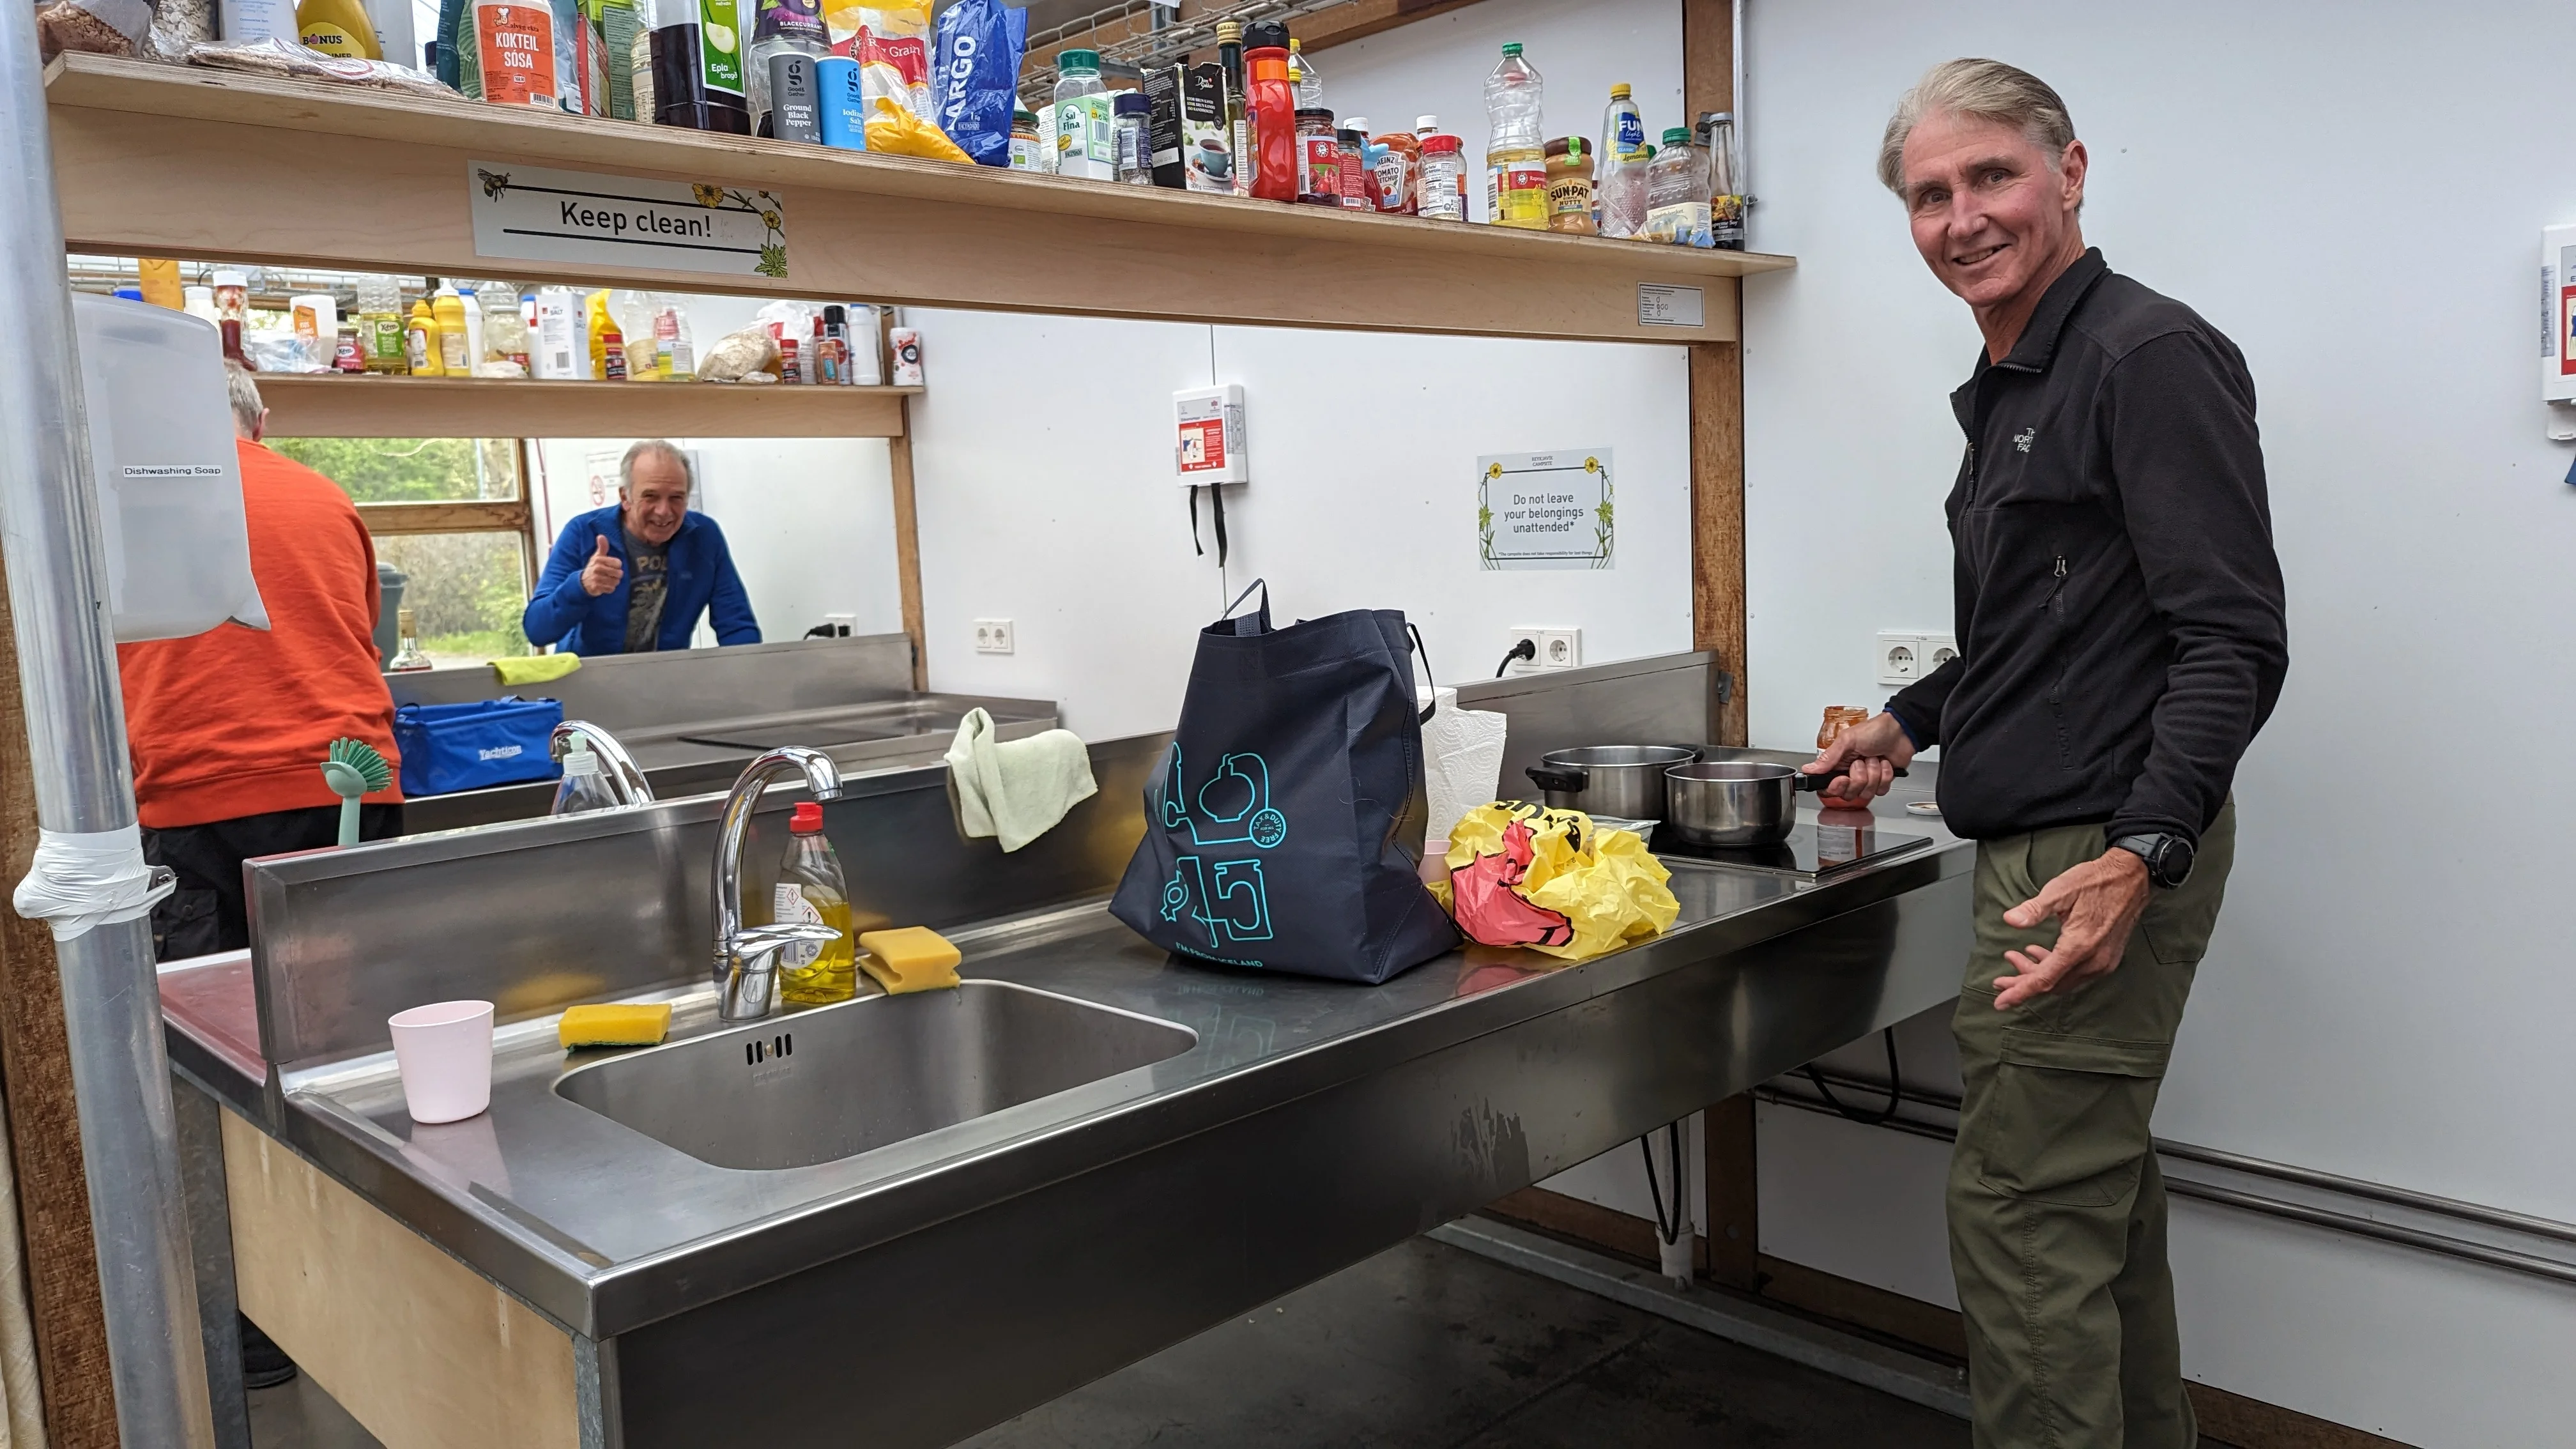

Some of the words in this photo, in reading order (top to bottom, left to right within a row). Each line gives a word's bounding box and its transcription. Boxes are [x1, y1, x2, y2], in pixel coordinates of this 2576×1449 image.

[779, 21, 822, 31] BLACKCURRANT
[496, 32, 539, 52] KOKTEIL
[889, 43, 921, 57] Grain
[503, 49, 533, 69] SÓSA
[711, 63, 729, 74] Epla
[720, 70, 738, 80] bragð
[945, 35, 977, 130] ARGO
[783, 103, 812, 112] Ground
[787, 111, 809, 119] Black
[1065, 111, 1076, 121] Sal
[785, 119, 812, 128] Pepper
[1062, 121, 1080, 131] Fina
[1618, 119, 1644, 133] FUN
[1377, 156, 1395, 166] HEINZ
[1375, 167, 1399, 178] TOMATO
[1378, 174, 1399, 183] ETCHUP
[561, 201, 627, 235] Keep
[636, 208, 712, 238] clean!
[2026, 427, 2036, 436] TH
[2012, 434, 2034, 444] NORT
[2016, 443, 2031, 453] FAC
[125, 466, 192, 475] Dishwashing
[194, 466, 221, 475] Soap
[1514, 494, 1526, 505] Do
[1529, 493, 1545, 505] not
[1547, 493, 1574, 503] leave
[1504, 510, 1526, 523] your
[1528, 507, 1584, 521] belongings
[479, 746, 523, 760] Yachticon
[1253, 815, 1264, 831] TAX
[1269, 813, 1282, 833] DUTY
[1260, 832, 1280, 843] FREE
[1176, 941, 1190, 955] I'M
[1218, 956, 1264, 968] ICELAND
